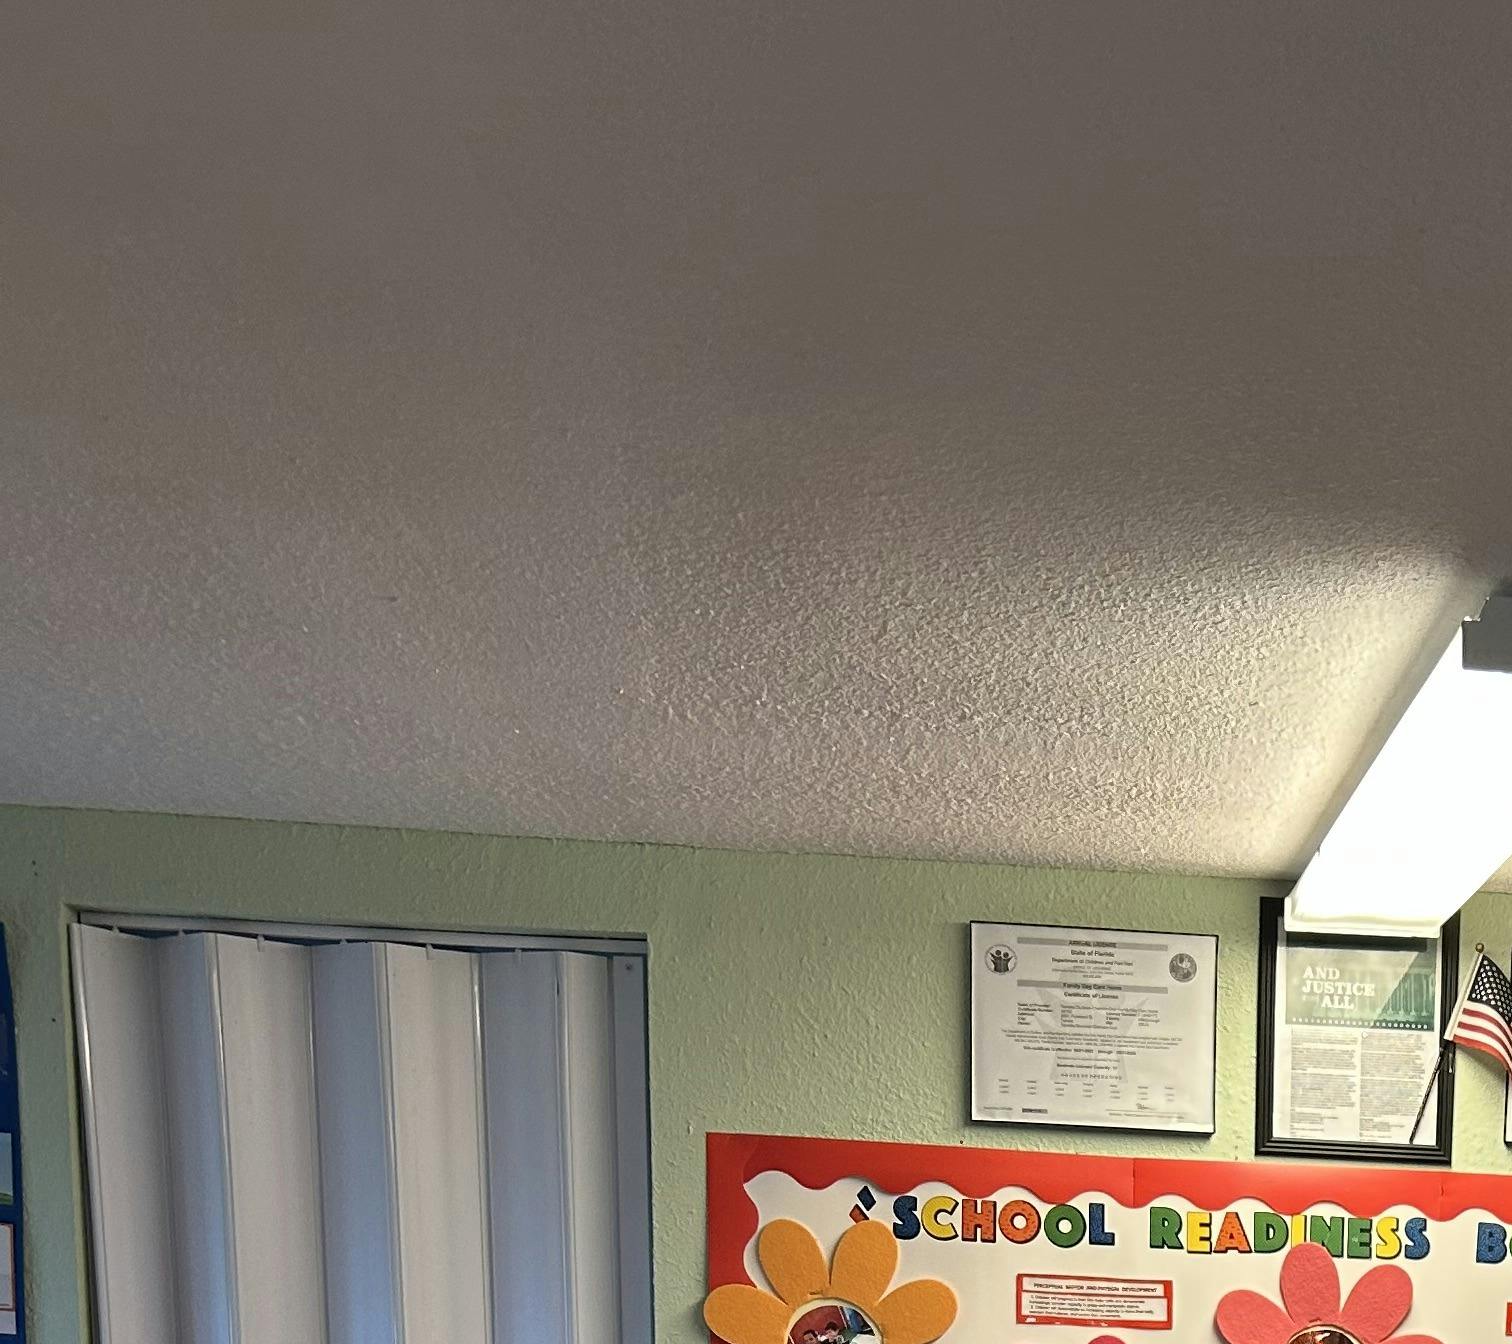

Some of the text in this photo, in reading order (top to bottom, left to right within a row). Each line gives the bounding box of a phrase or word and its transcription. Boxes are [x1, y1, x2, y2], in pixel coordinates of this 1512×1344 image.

[1303, 966, 1340, 980] AND
[1302, 980, 1375, 997] JUSTICE
[1321, 995, 1354, 1009] ALL
[1149, 1206, 1431, 1260] READINESS
